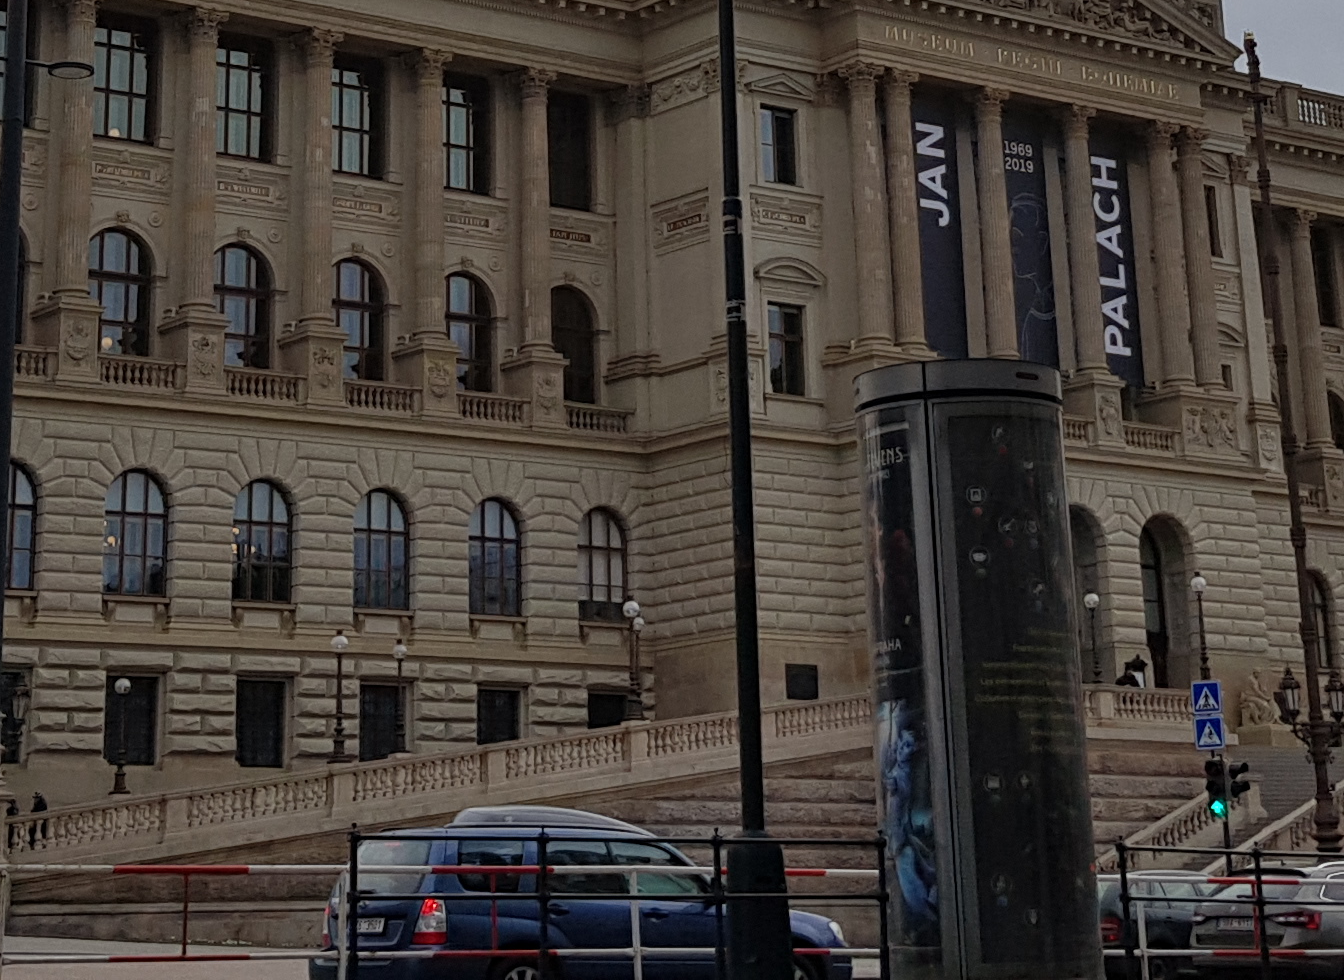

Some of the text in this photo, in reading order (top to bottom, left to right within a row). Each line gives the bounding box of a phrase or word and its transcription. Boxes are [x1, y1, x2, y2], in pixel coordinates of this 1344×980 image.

[885, 25, 975, 57] MUSEUM
[1004, 140, 1034, 158] 1969
[914, 121, 950, 227] JAN
[1005, 158, 1035, 174] 2019
[1089, 155, 1132, 357] PALACH
